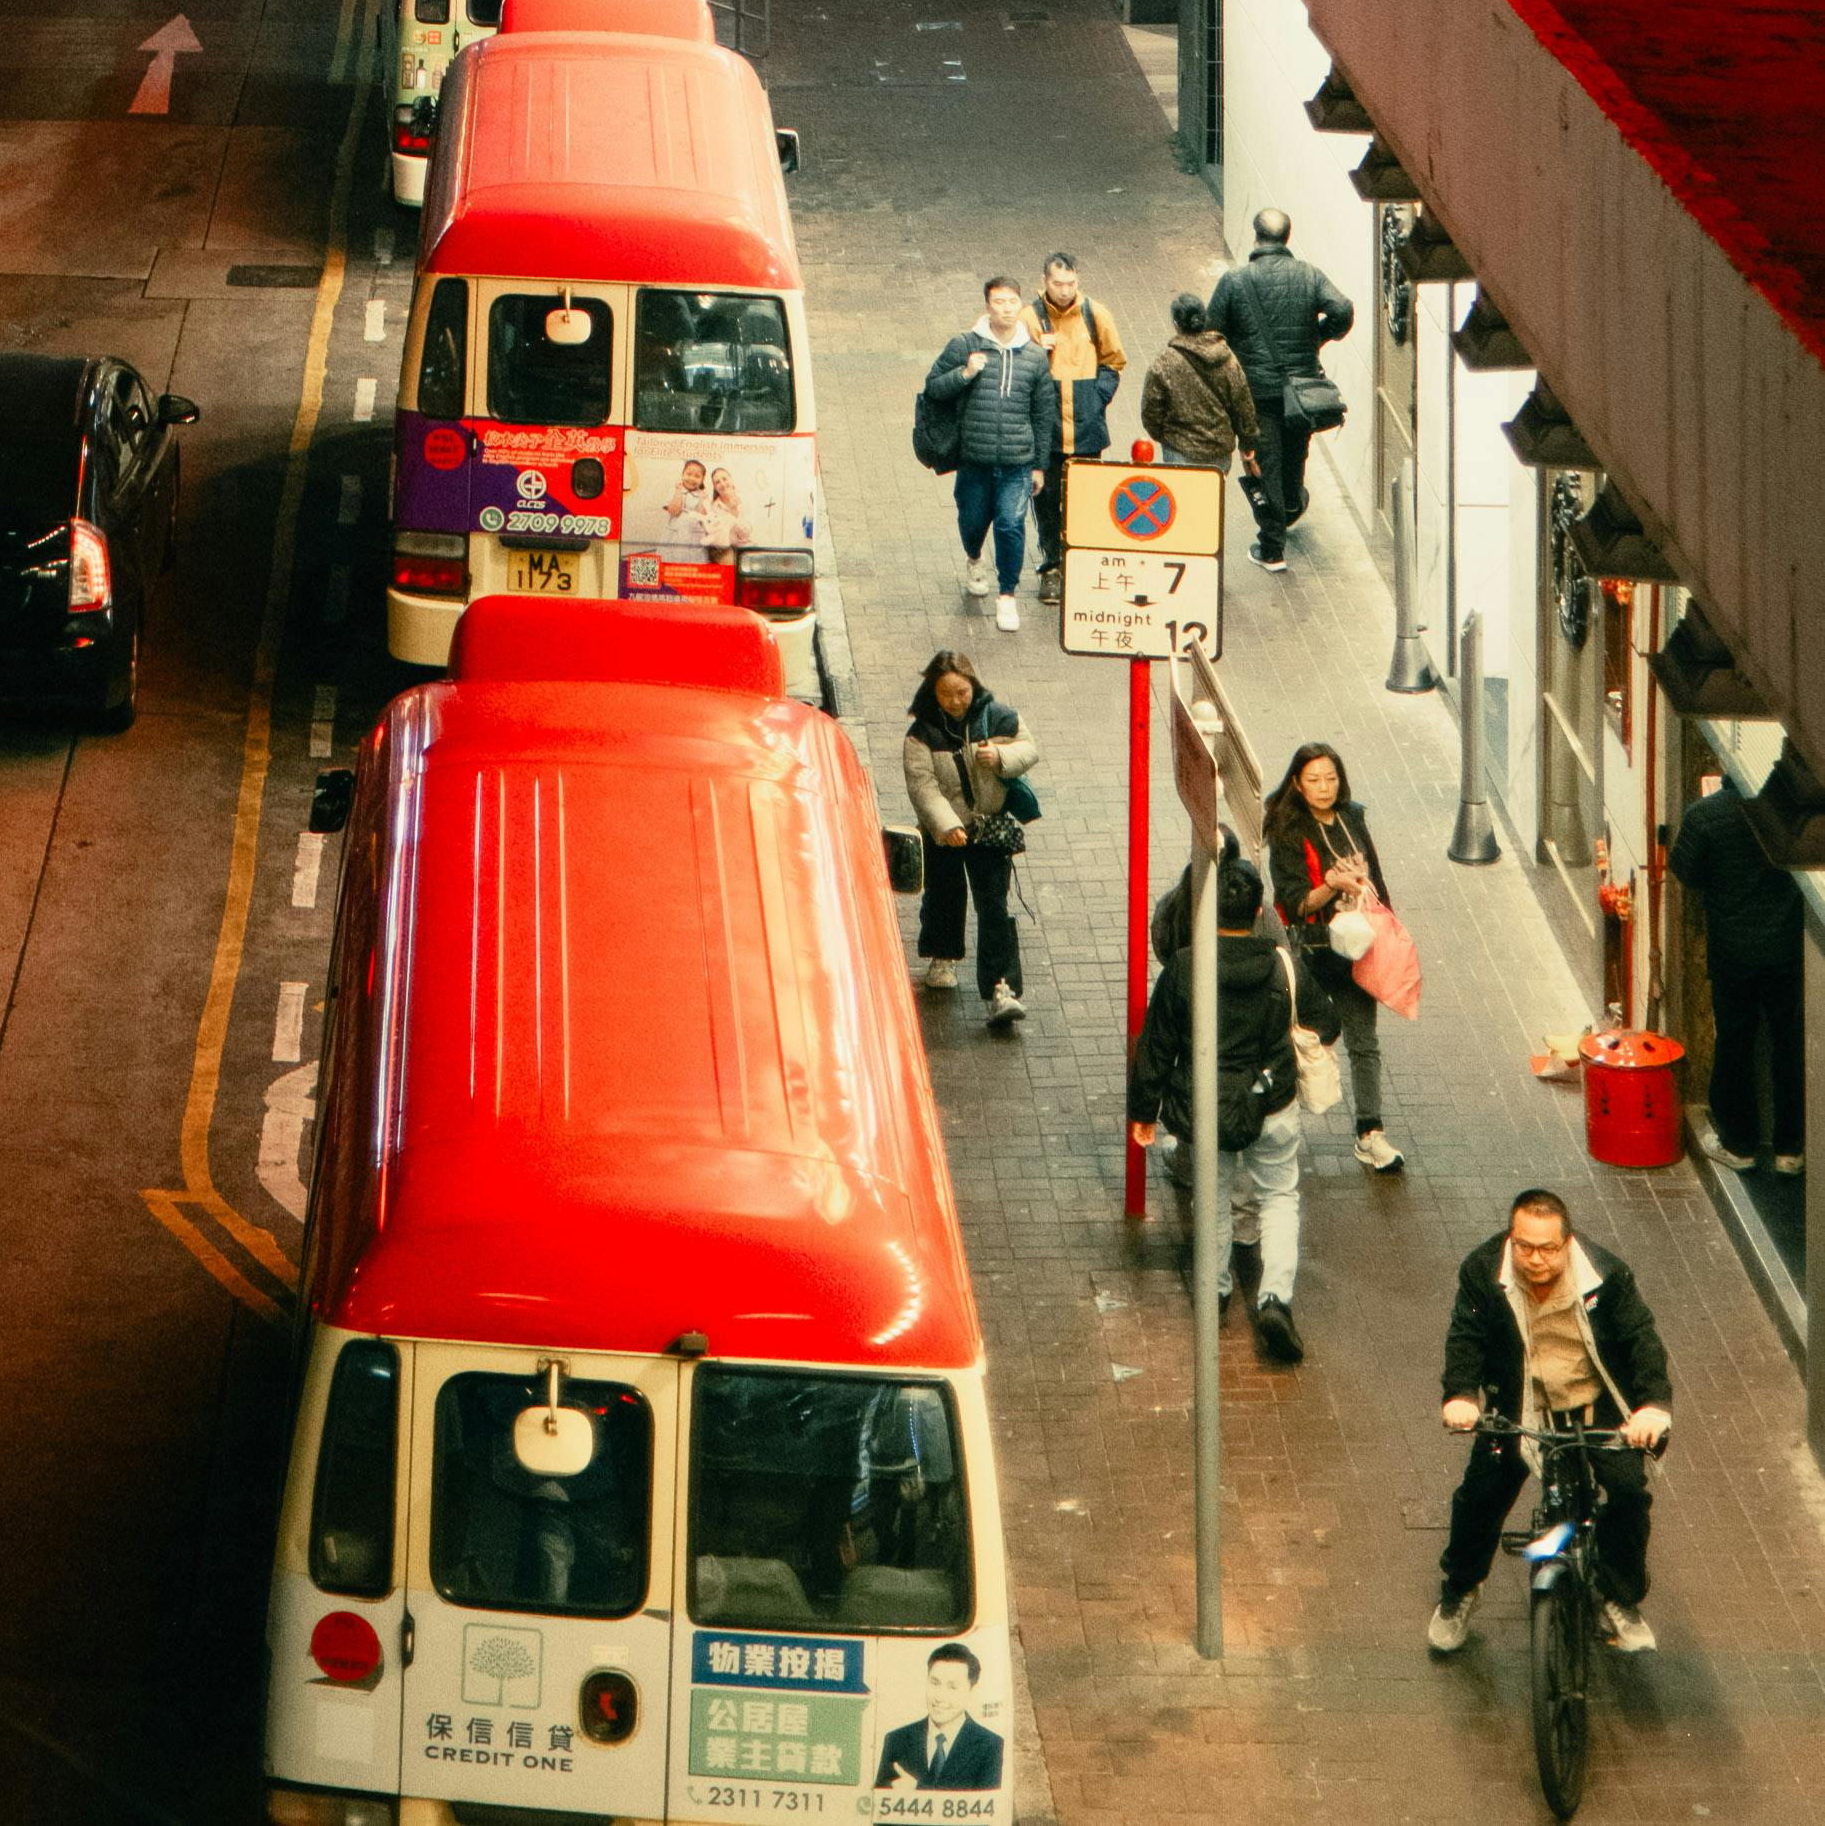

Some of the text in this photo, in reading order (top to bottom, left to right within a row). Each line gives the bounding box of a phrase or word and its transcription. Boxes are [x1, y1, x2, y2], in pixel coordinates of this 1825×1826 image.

[507, 512, 611, 536] 2709 9978
[528, 553, 561, 573] MA
[1100, 555, 1126, 567] am
[517, 570, 572, 591] 1173
[1091, 571, 1135, 592] 上午
[1163, 561, 1186, 595] 7
[1073, 611, 1152, 627] midnight
[1090, 627, 1134, 650] 午夜
[1164, 619, 1208, 653] 12
[707, 1641, 846, 1682] 物業按揭
[426, 1713, 575, 1754] 保信信貸
[424, 1745, 574, 1773] CREDIT ONE
[708, 1786, 825, 1812] 2311 7311
[879, 1797, 996, 1819] 5444 8844
